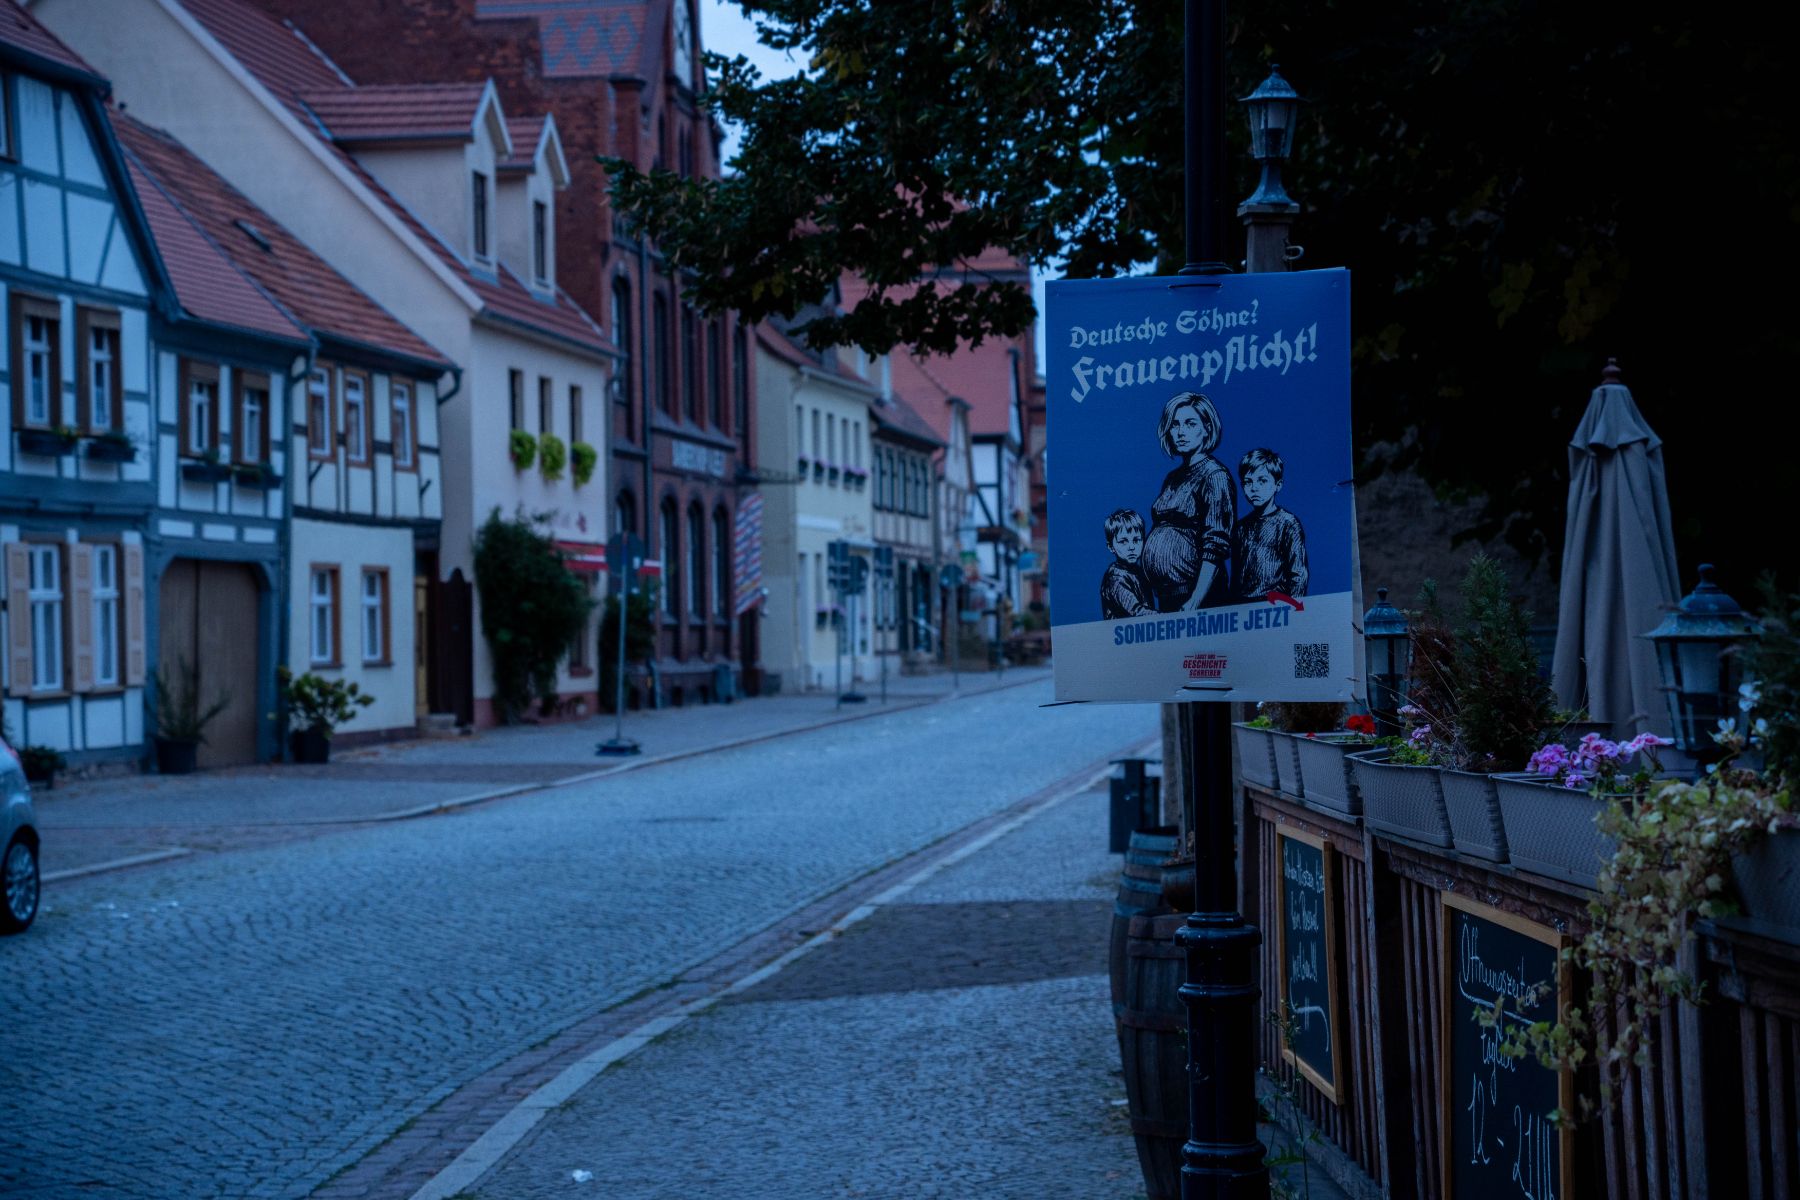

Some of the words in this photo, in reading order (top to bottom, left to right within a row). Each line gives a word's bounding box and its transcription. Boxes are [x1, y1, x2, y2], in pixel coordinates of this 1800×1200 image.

[1069, 316, 1168, 349] Deutsche
[1070, 321, 1318, 403] Frauenpflicht!
[1114, 612, 1238, 645] SONDERPRÄMIE
[1244, 605, 1291, 631] JETZT
[1183, 659, 1227, 669] GESCHICHTE
[1189, 669, 1221, 677] SCHREIBEN
[1461, 914, 1540, 1007] Öffnungszeiten
